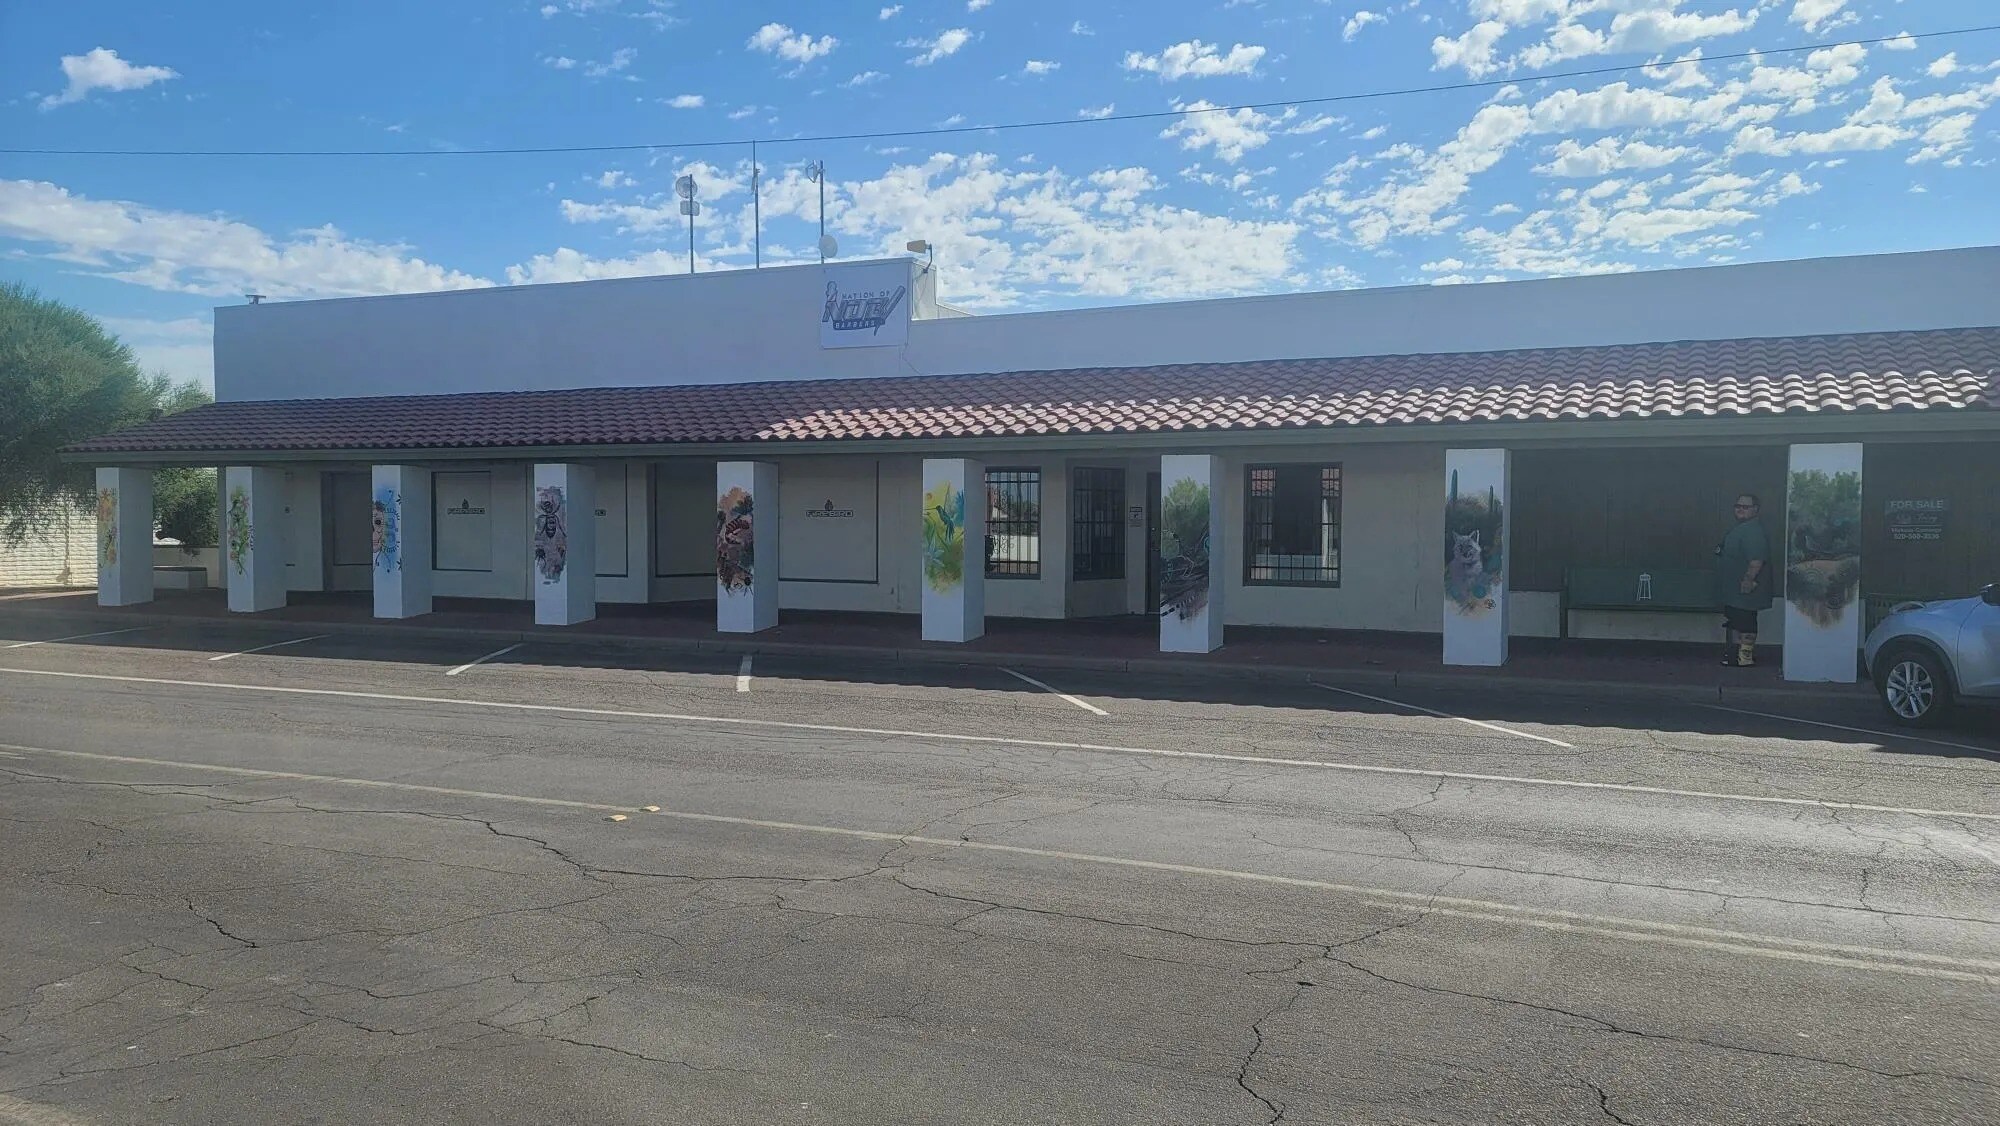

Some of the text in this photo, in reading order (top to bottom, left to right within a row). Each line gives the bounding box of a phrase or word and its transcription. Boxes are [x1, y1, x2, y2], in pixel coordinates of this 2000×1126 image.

[841, 291, 874, 300] NATION
[835, 319, 875, 329] BARBERS
[1890, 500, 1943, 509] FOR SALE
